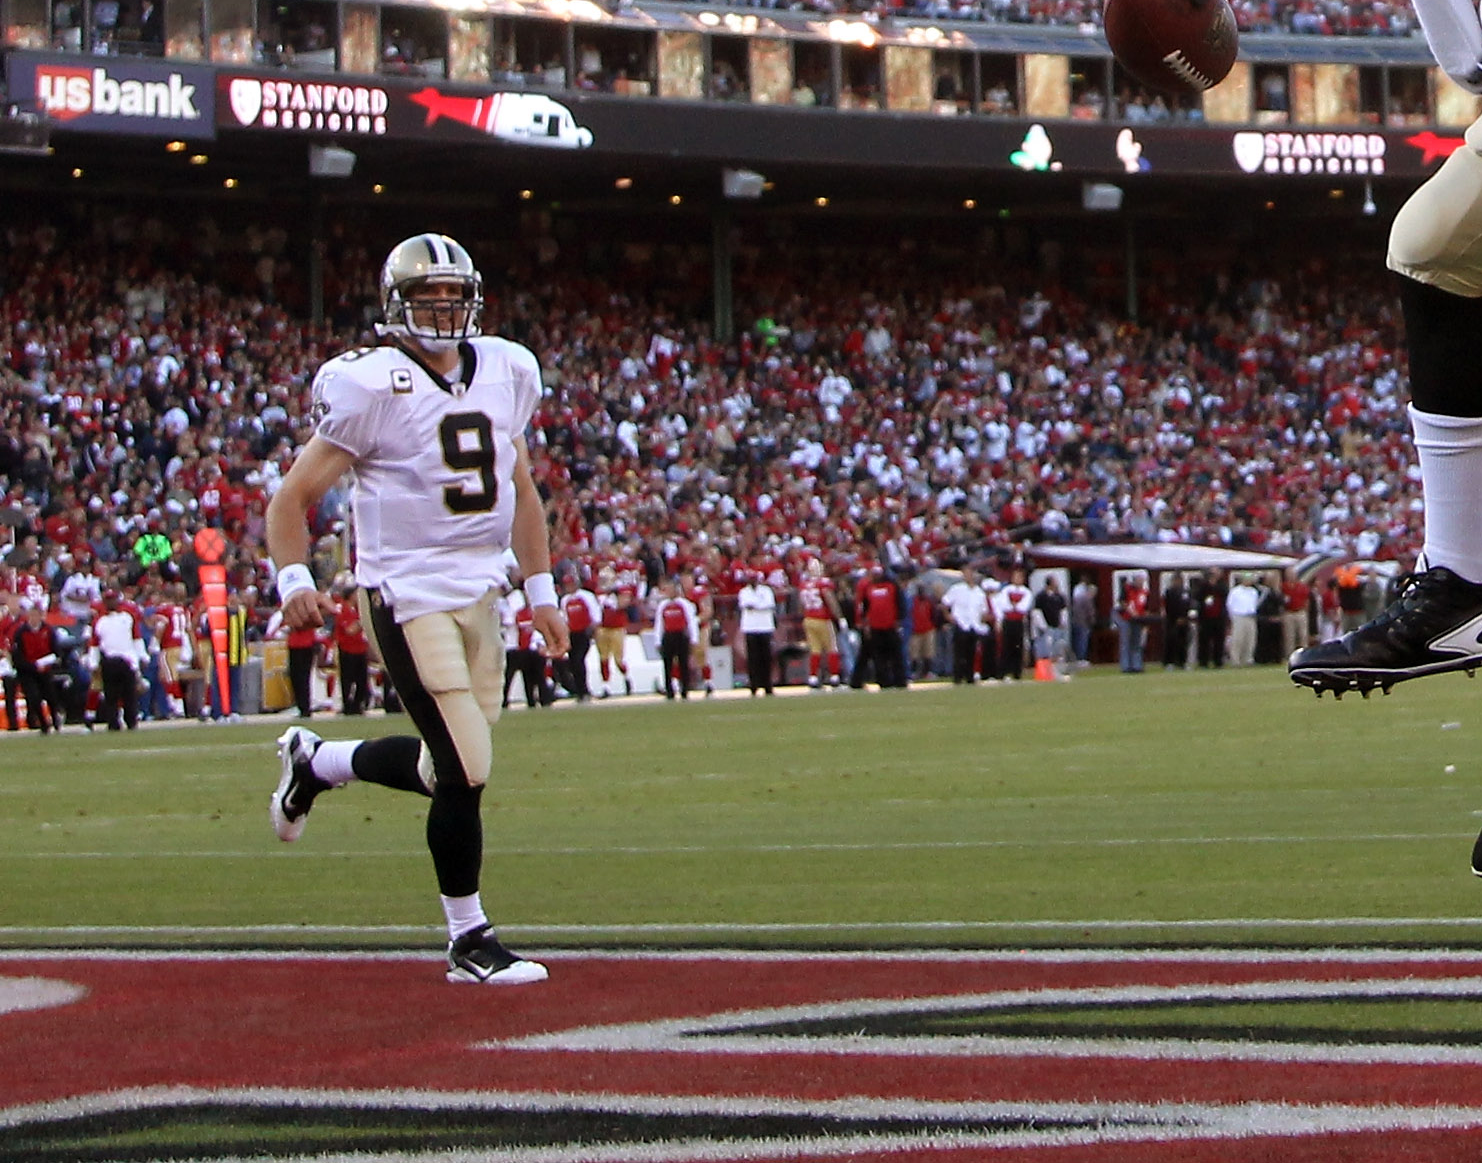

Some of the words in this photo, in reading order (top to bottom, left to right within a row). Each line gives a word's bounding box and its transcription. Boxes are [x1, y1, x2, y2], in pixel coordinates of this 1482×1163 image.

[38, 68, 197, 120] usbank
[261, 82, 389, 115] STANFORD
[261, 109, 387, 134] MEDICINE
[1265, 132, 1386, 157] STANFORD
[438, 410, 499, 516] 9
